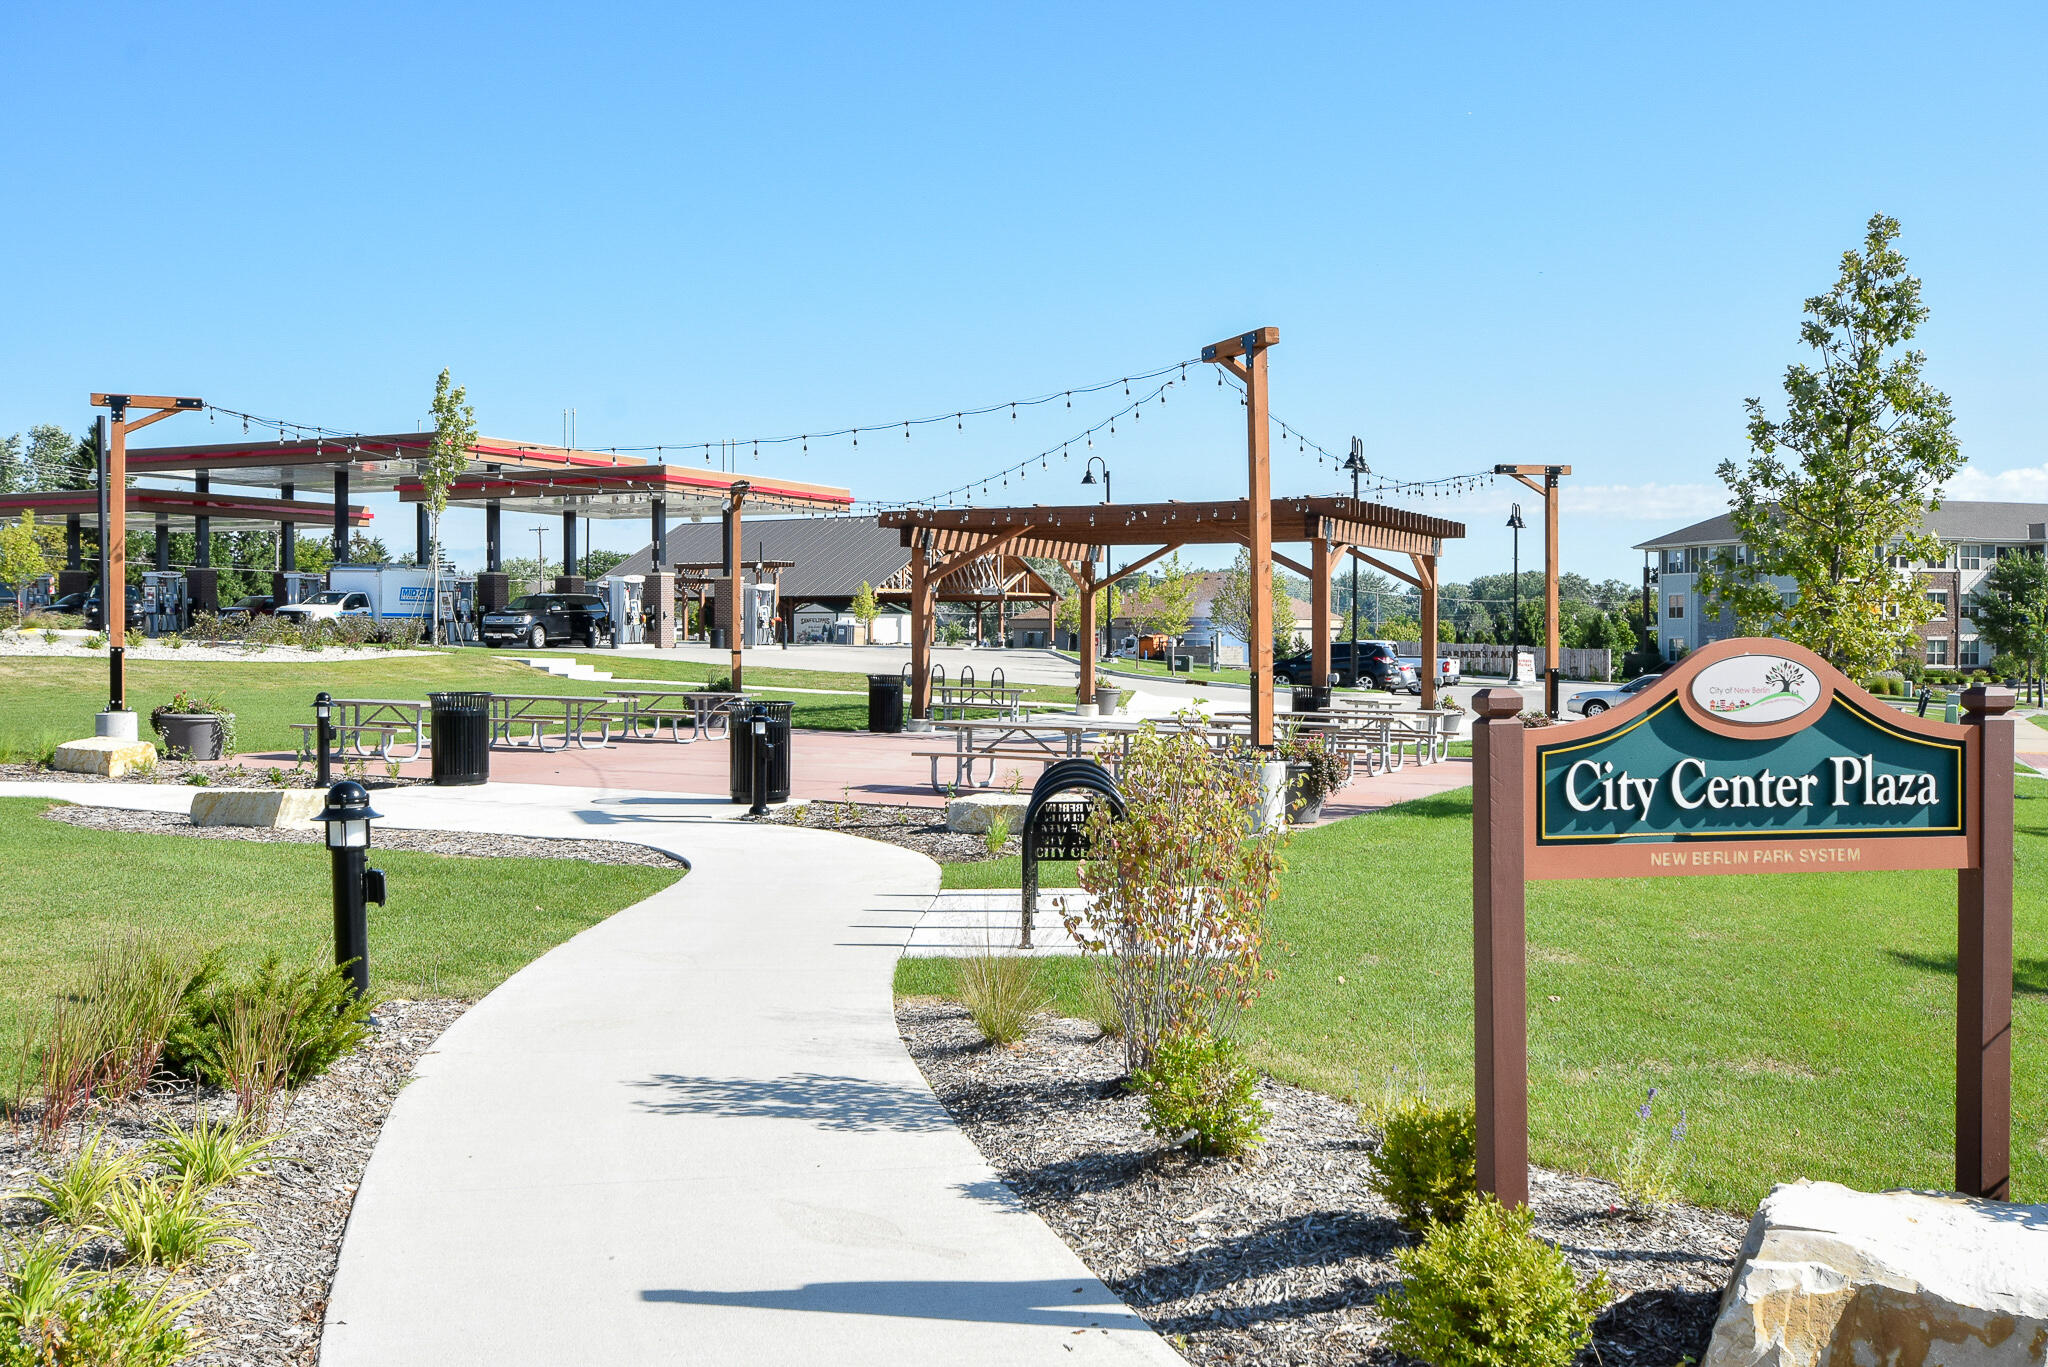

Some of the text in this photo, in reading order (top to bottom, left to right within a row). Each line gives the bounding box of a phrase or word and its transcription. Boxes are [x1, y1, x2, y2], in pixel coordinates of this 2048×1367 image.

[1709, 686, 1724, 695] City
[1725, 686, 1733, 694] of
[1752, 686, 1771, 694] Berlin
[1565, 753, 1939, 821] City Center Plaza
[1036, 847, 1066, 858] CITY
[1650, 847, 1861, 867] NEW BERLIN PARK SYSTEM
